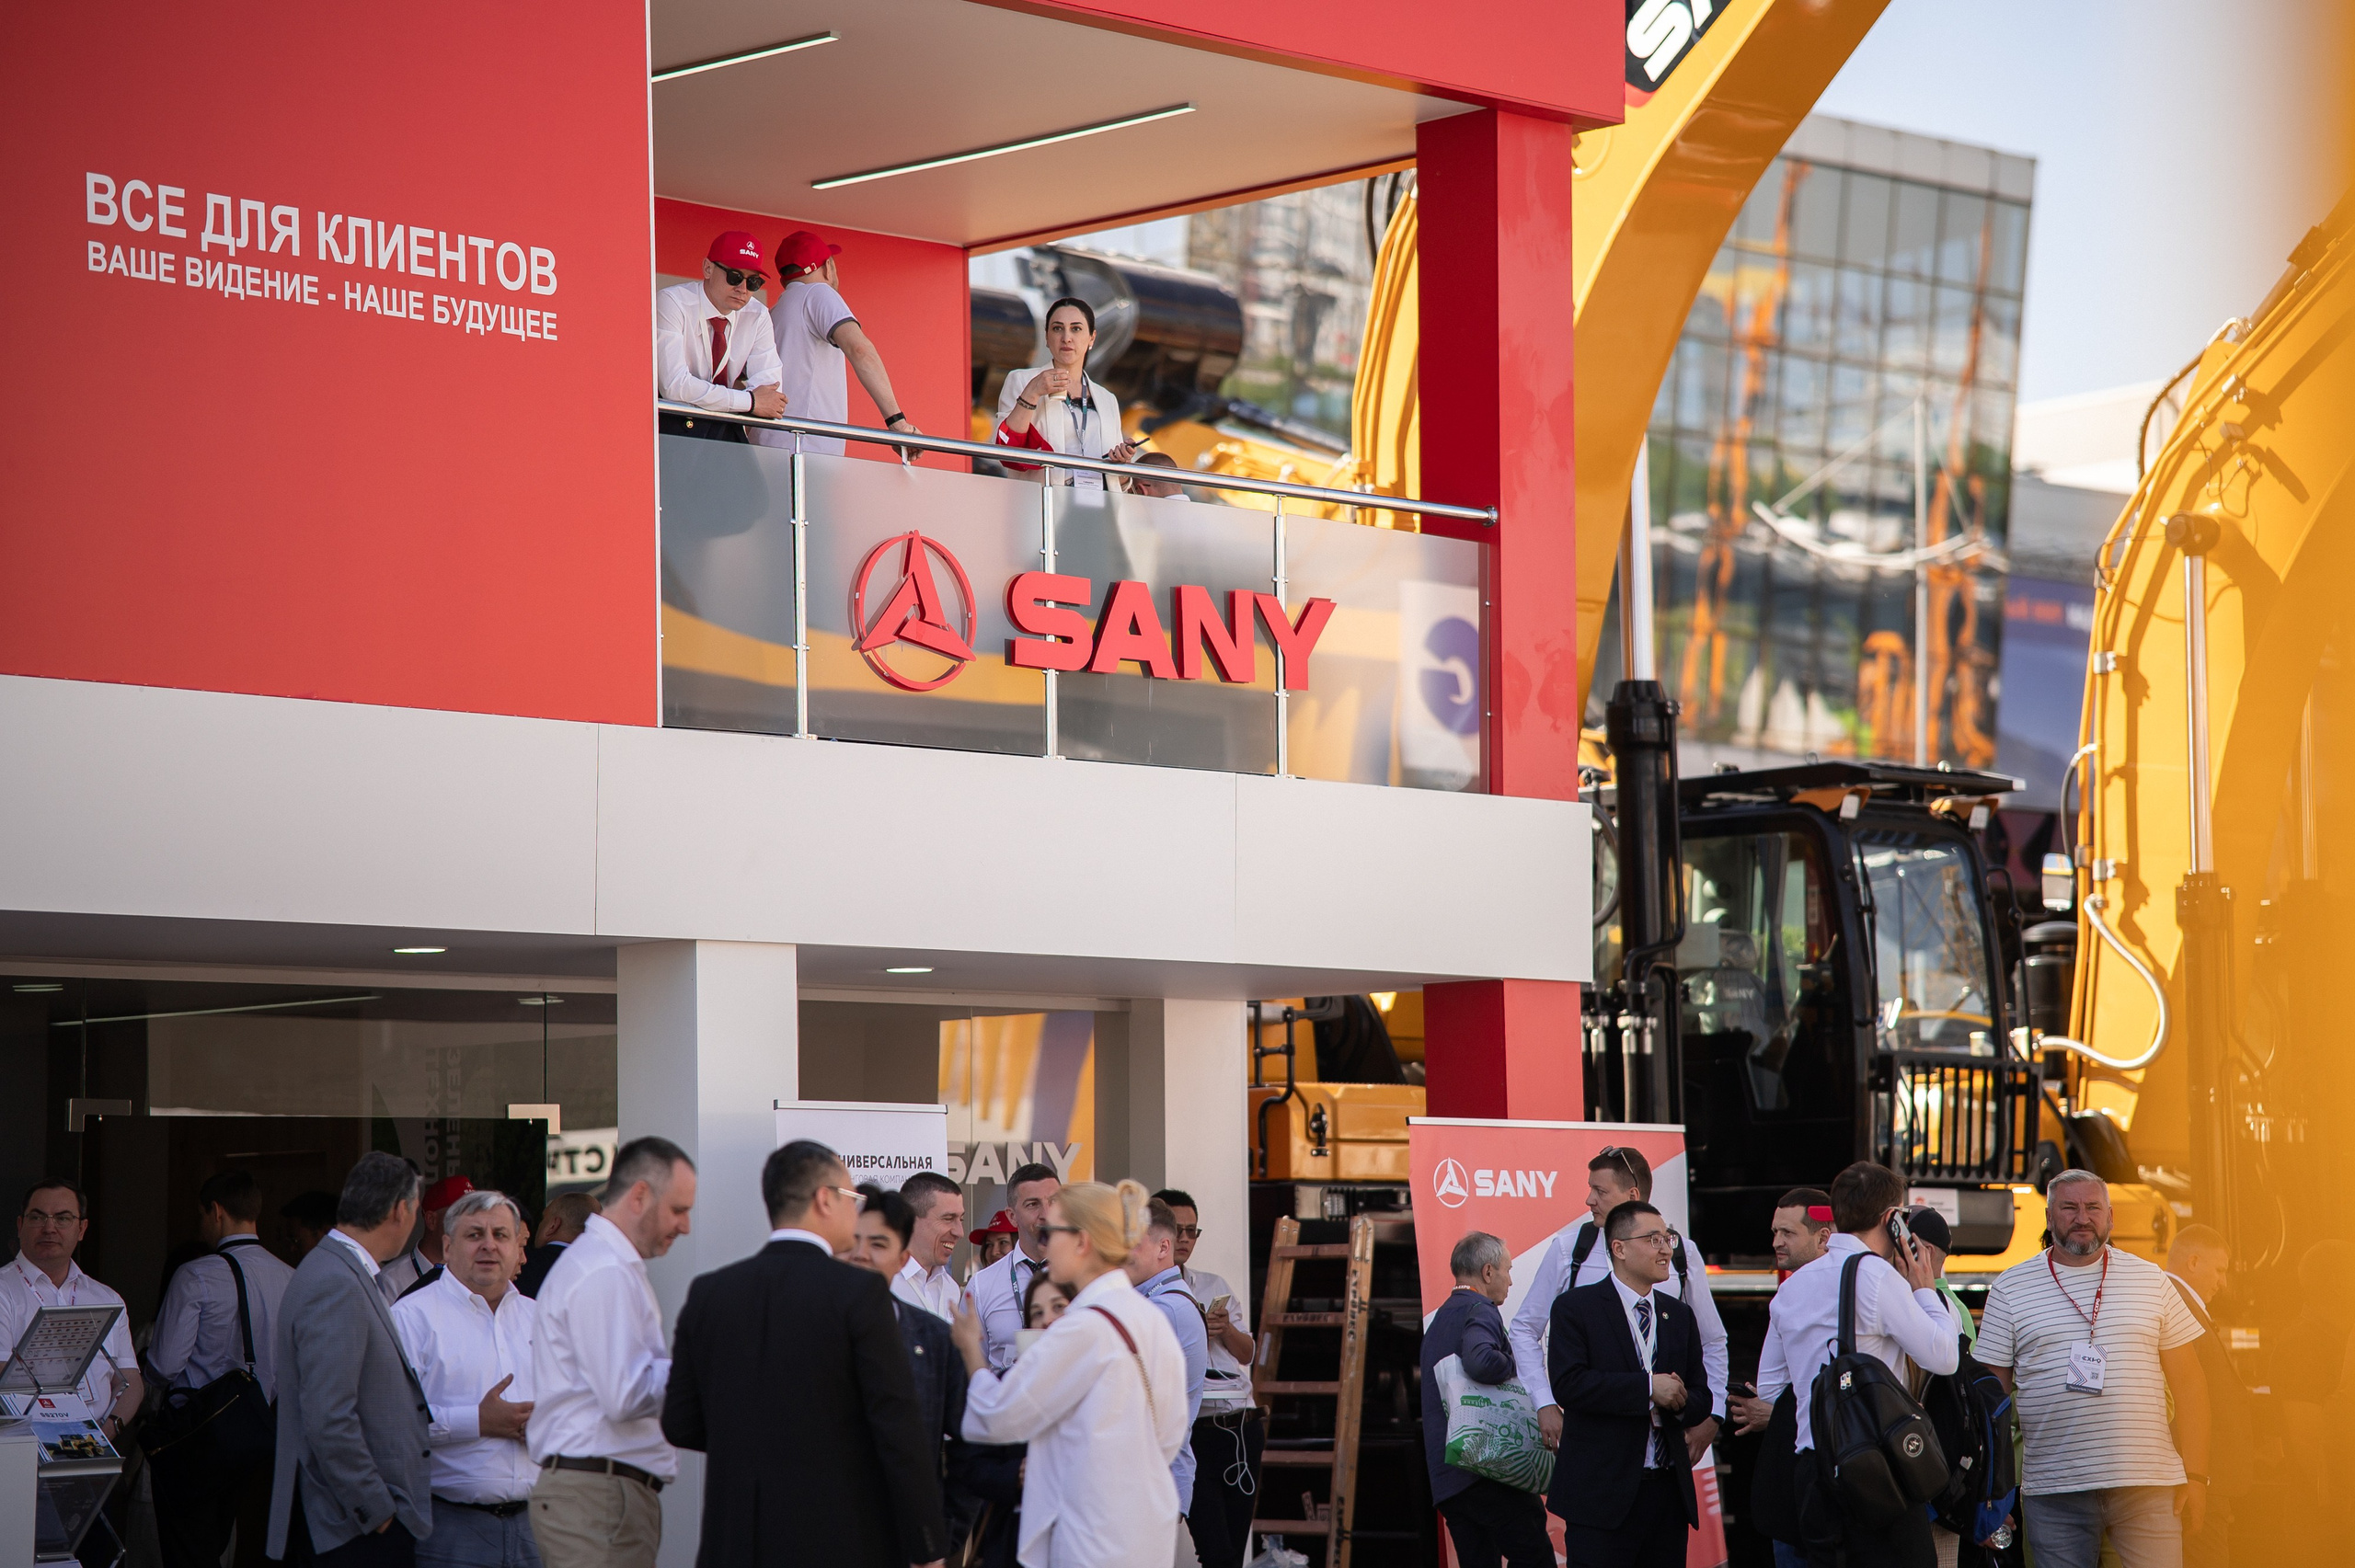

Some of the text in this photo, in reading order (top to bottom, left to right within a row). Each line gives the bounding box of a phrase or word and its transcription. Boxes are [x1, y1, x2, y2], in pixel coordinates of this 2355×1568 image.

[86, 172, 557, 296] ВСЕ ДЛЯ КЛИЕНТОВ
[740, 248, 759, 259] SANY
[87, 240, 558, 342] ВАШЕ ВИДЕНИЕ - НАШЕ БУДУЩЕЕ
[1005, 570, 1337, 692] SANY
[1474, 1169, 1558, 1198] SANY
